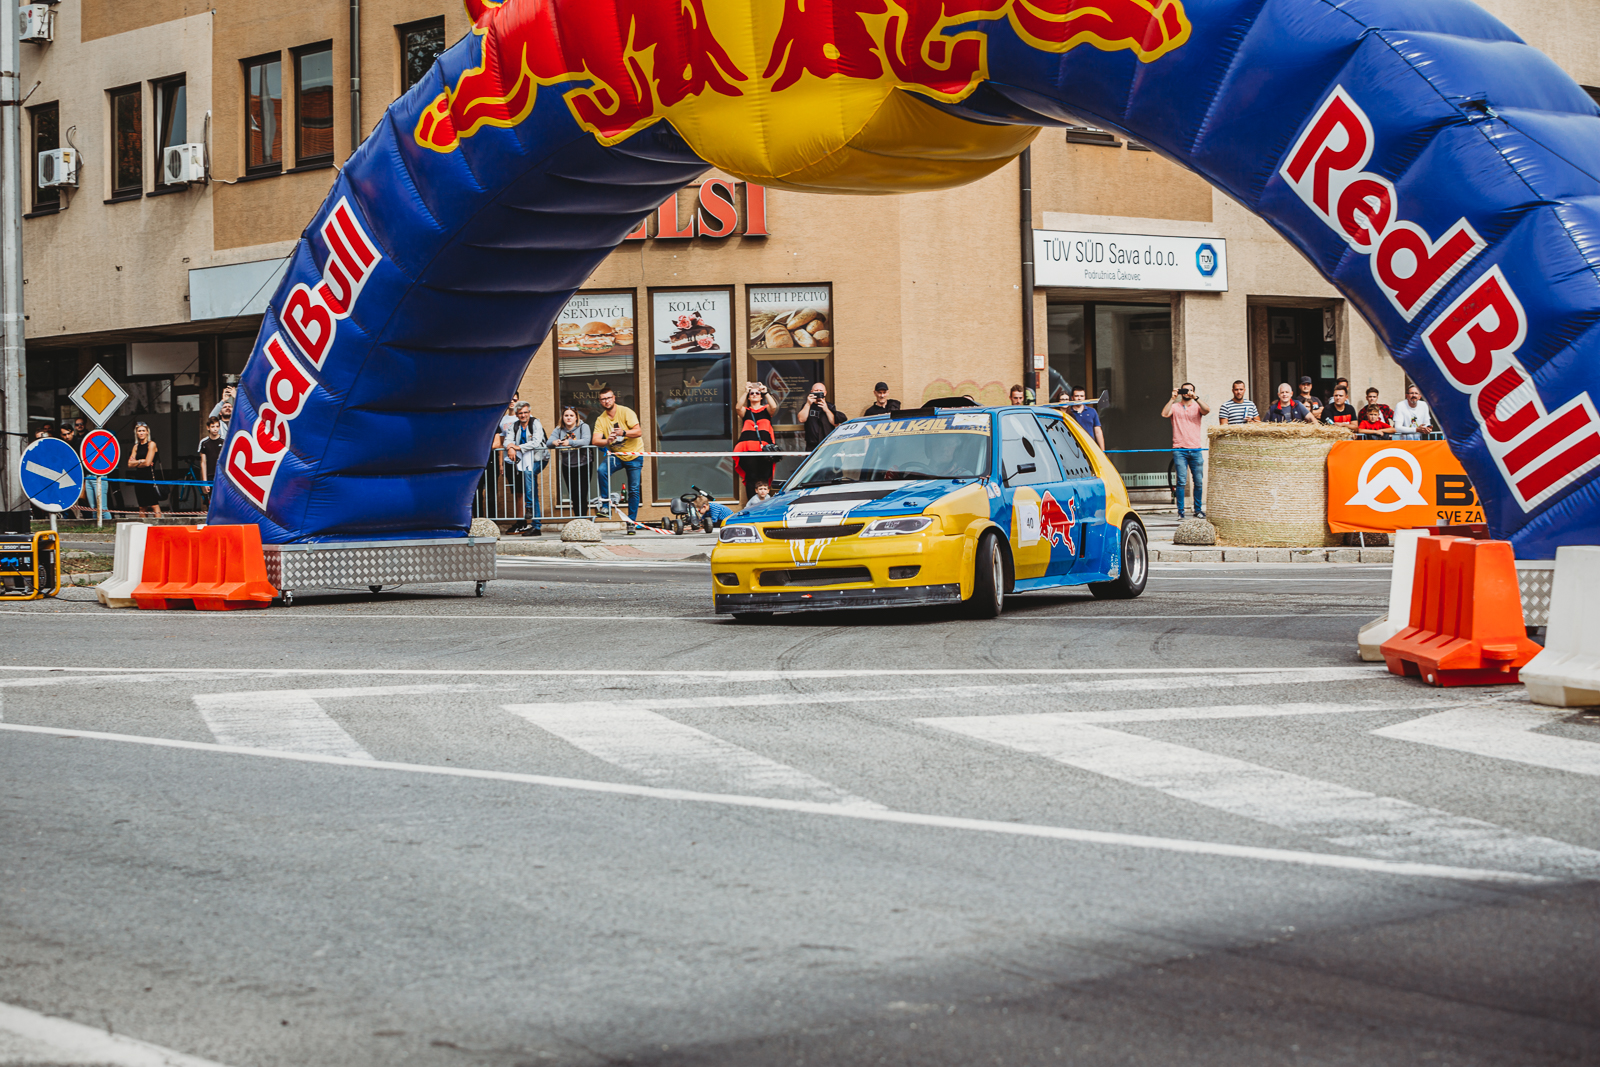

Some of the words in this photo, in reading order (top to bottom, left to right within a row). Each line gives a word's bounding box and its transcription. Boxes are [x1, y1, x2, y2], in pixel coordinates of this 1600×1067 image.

[1043, 238, 1071, 261] TÜV
[1075, 239, 1104, 263] SÜD
[1109, 242, 1139, 265] Sava
[1144, 245, 1178, 266] d.o.o.
[1084, 269, 1116, 280] Podružnica
[1116, 269, 1141, 281] Čakovec
[753, 292, 781, 303] KRUH
[784, 292, 788, 302] I
[791, 291, 827, 302] PECIVO
[1285, 92, 1478, 313] Red
[1427, 272, 1600, 503] Bull
[668, 299, 715, 312] KOLAČI
[563, 306, 625, 319] SENDVIČI
[227, 336, 313, 506] Red
[282, 202, 378, 366] Bull
[669, 388, 718, 397] KRALJEVSKE
[842, 423, 858, 431] 40
[1437, 511, 1461, 522] SVE
[1026, 517, 1034, 529] 40
